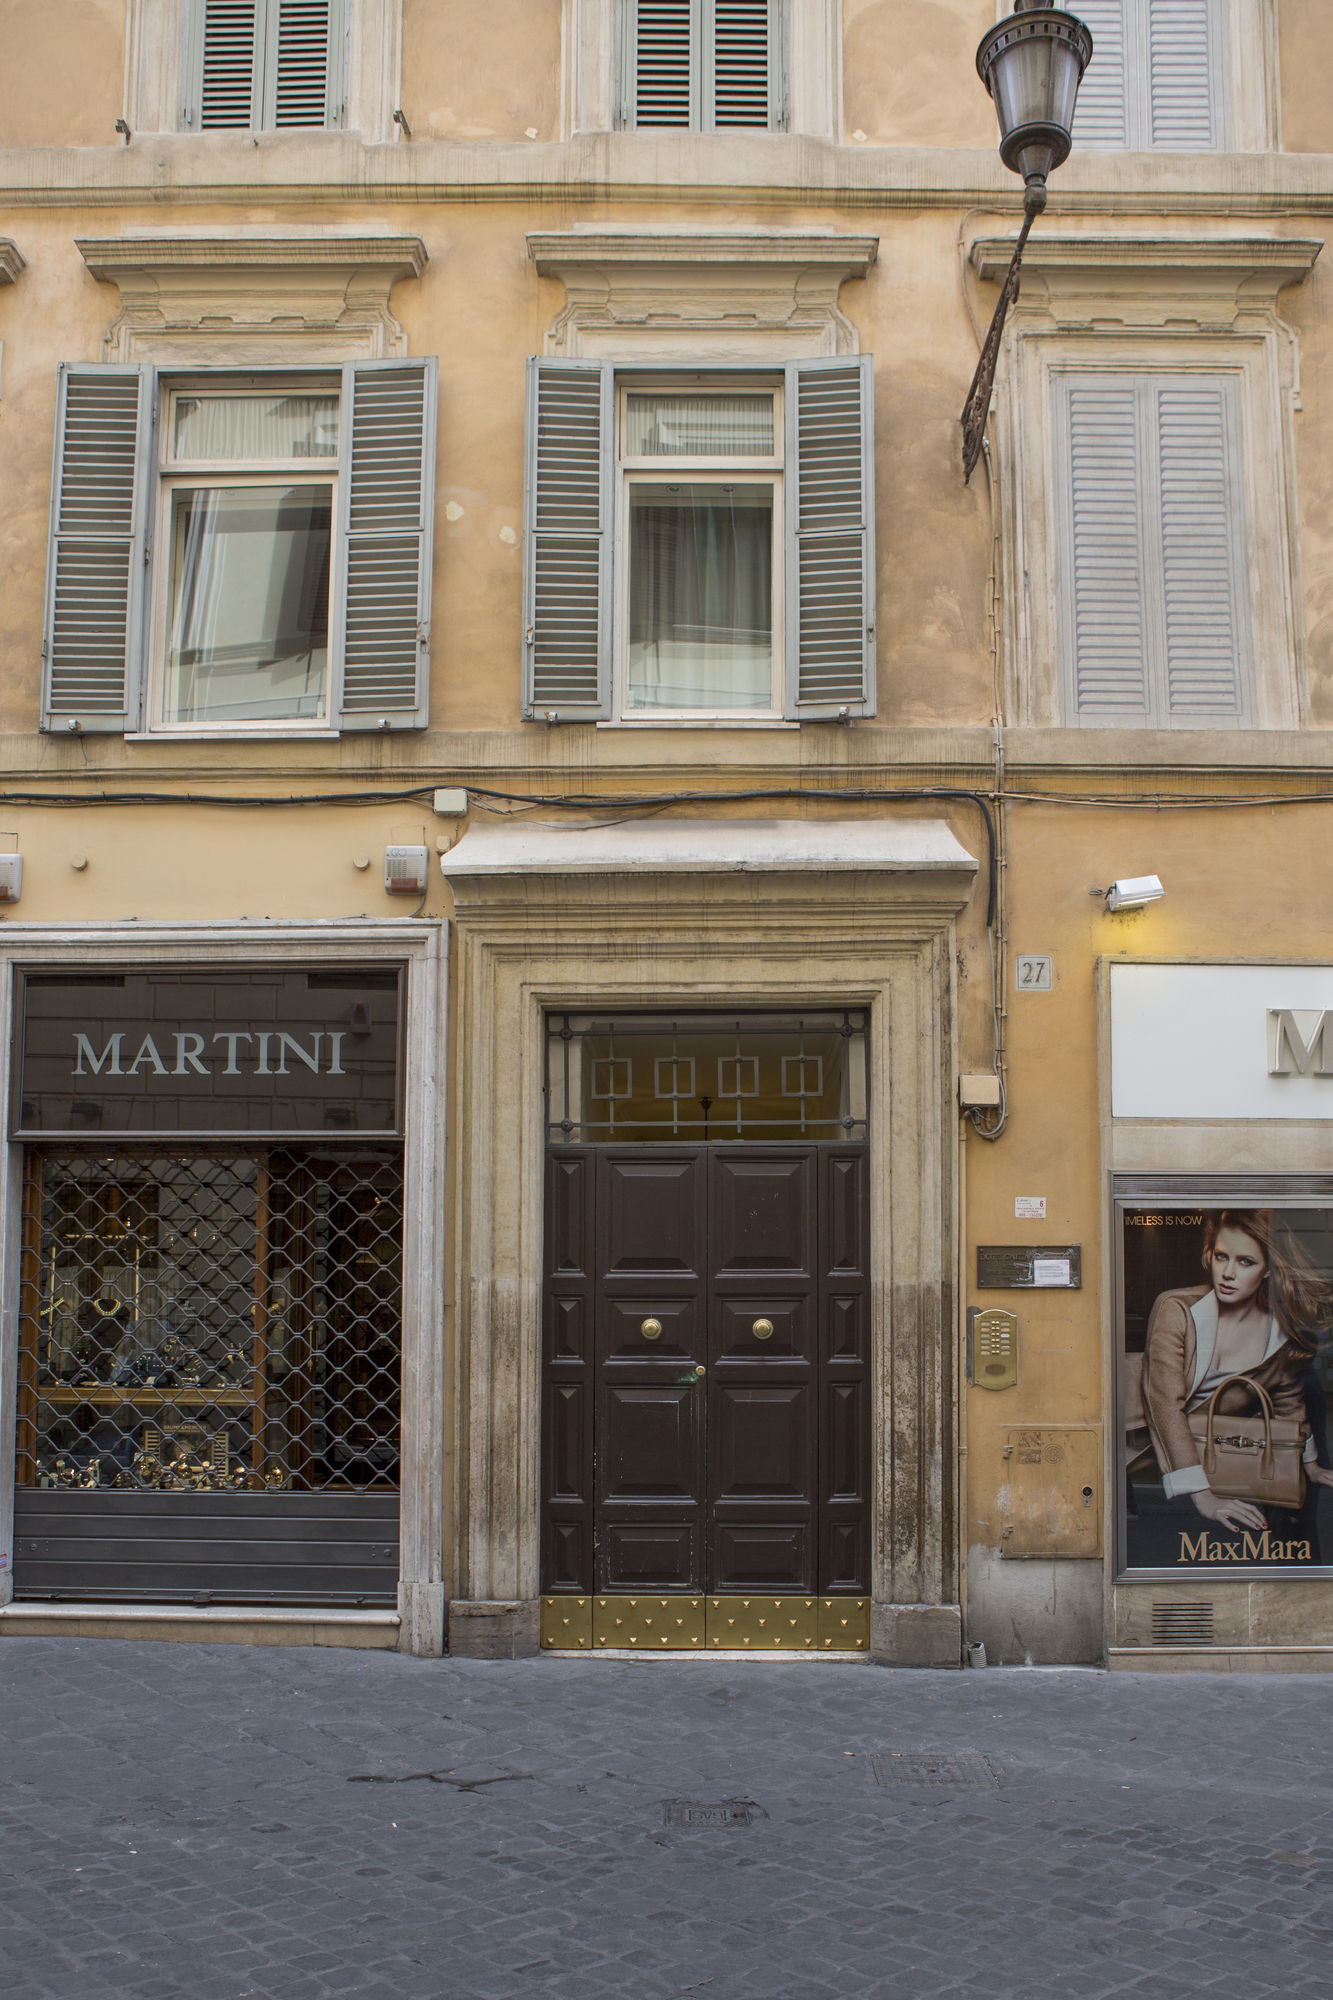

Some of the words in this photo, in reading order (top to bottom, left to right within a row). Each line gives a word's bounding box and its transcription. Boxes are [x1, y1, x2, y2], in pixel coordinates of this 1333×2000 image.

[1023, 962, 1045, 983] 27
[72, 1032, 346, 1074] MARTINI
[1165, 1215, 1174, 1226] IS
[1175, 1215, 1203, 1226] NOW
[1177, 1530, 1312, 1561] MaxMara
